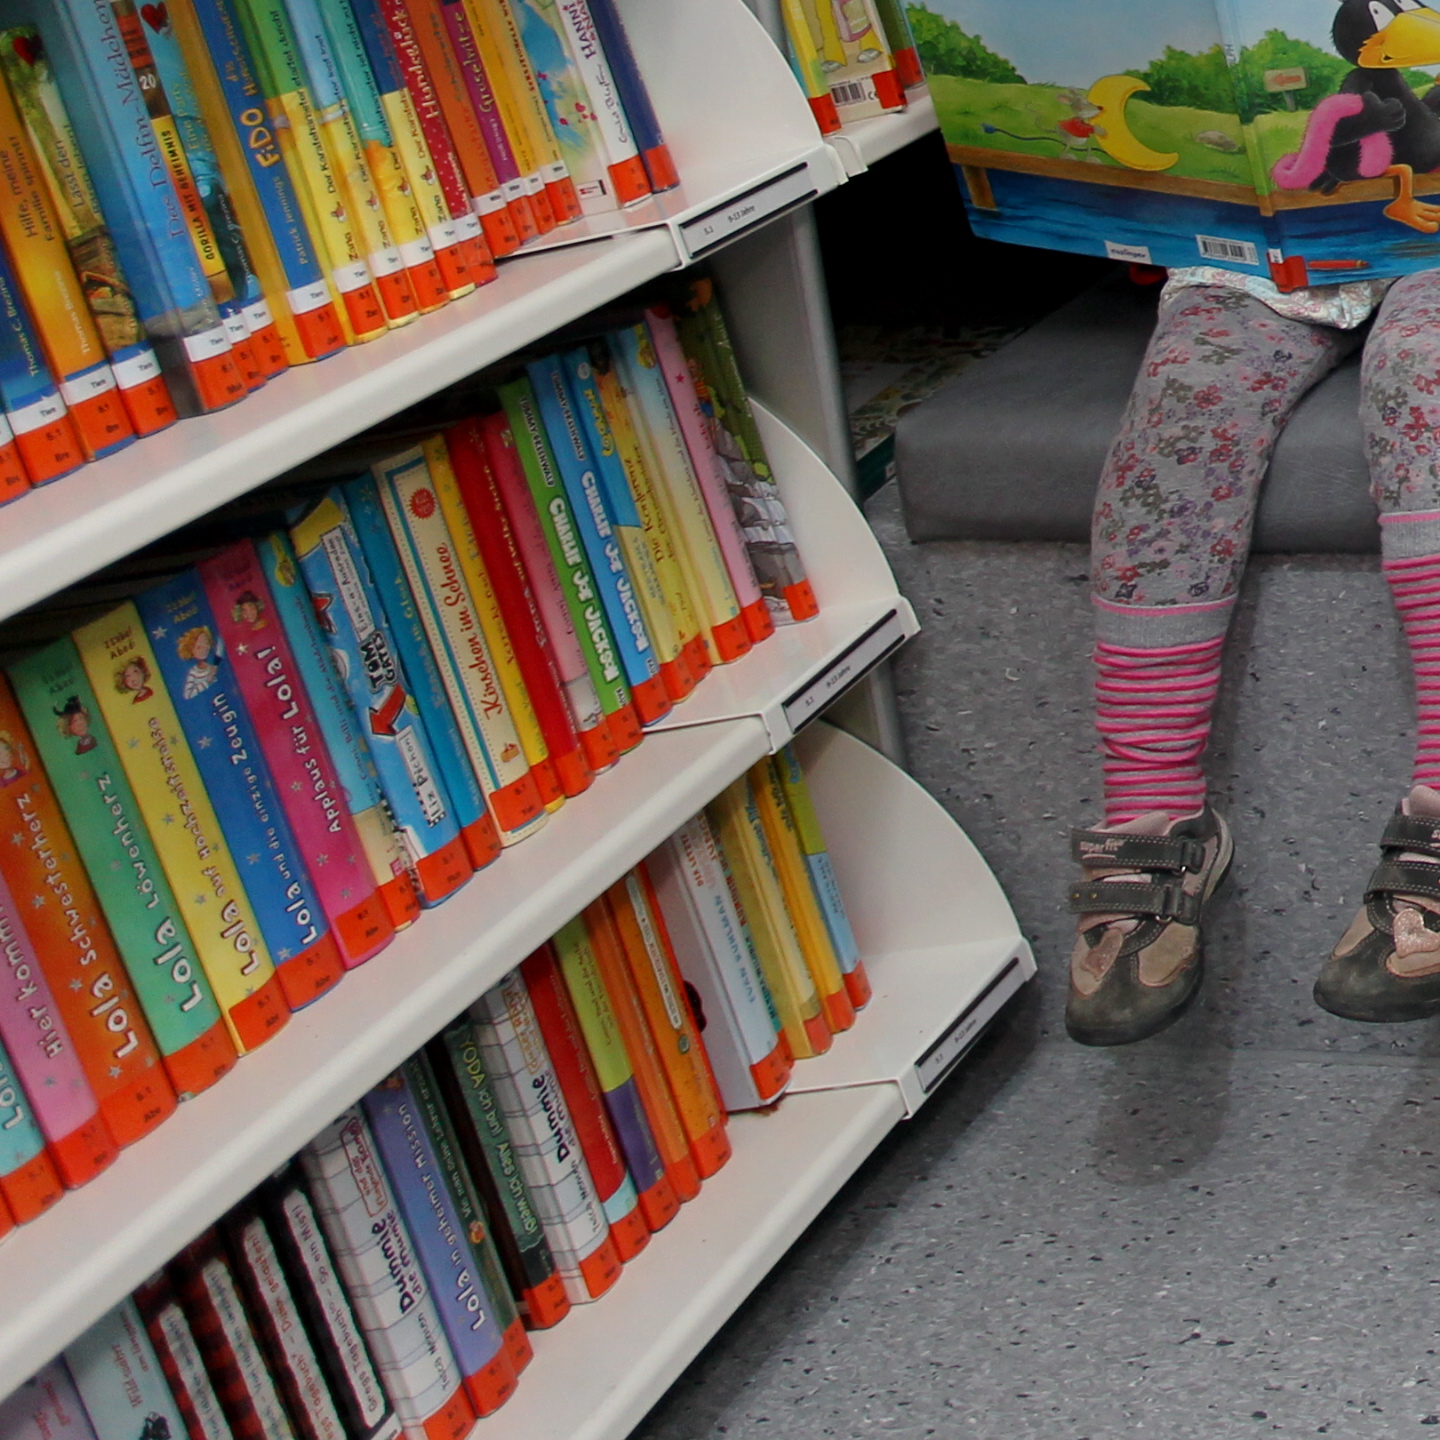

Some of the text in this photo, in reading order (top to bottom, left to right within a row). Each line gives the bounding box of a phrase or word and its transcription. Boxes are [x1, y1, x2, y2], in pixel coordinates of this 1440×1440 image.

[391, 9, 441, 120] Hundeglück
[455, 11, 496, 114] Gruselwitze
[563, 4, 598, 60] HANNI
[139, 73, 158, 92] 20
[0, 149, 39, 238] Hilfe, meine
[9, 135, 56, 242] Familie spinnt!
[55, 140, 84, 208] Lasst den
[161, 129, 216, 262] GORILLA MIT GEHEIMNIS
[163, 196, 188, 240] Das
[271, 175, 308, 266] Patrick Jennings
[18, 330, 39, 377] Thomas
[54, 269, 91, 355] Thomas Brezina
[533, 433, 555, 488] GREENWALD
[549, 496, 620, 684] CHARLIE JOE JACKSON
[581, 471, 650, 653] CHARLIE JOE JACKSON
[359, 642, 383, 690] TOM
[372, 629, 398, 685] GATES
[437, 541, 504, 721] Kirschen im Schnee
[254, 645, 342, 834] Applaus für Lola!
[401, 733, 430, 787] Pichon
[149, 716, 262, 977] Lola auf Hochzeitsreise
[211, 691, 318, 945] Lola und die einzige Zeugin
[1078, 838, 1127, 854] superfit
[16, 792, 139, 1059] Lola Schwesterherz
[96, 771, 204, 1013] Lola Löwenherz
[713, 894, 743, 964] KUHLMAN
[30, 1005, 64, 1058] Hier
[459, 1033, 493, 1109] YODA ich
[531, 1072, 571, 1165] Dummie
[496, 1141, 523, 1198] Alles ich
[291, 1204, 313, 1242] Mist!
[397, 1102, 487, 1333] Lola in geheimer Mission
[250, 1233, 281, 1295] gelaufen!
[371, 1218, 416, 1315] Dummie
[433, 1356, 449, 1391] Tosca
